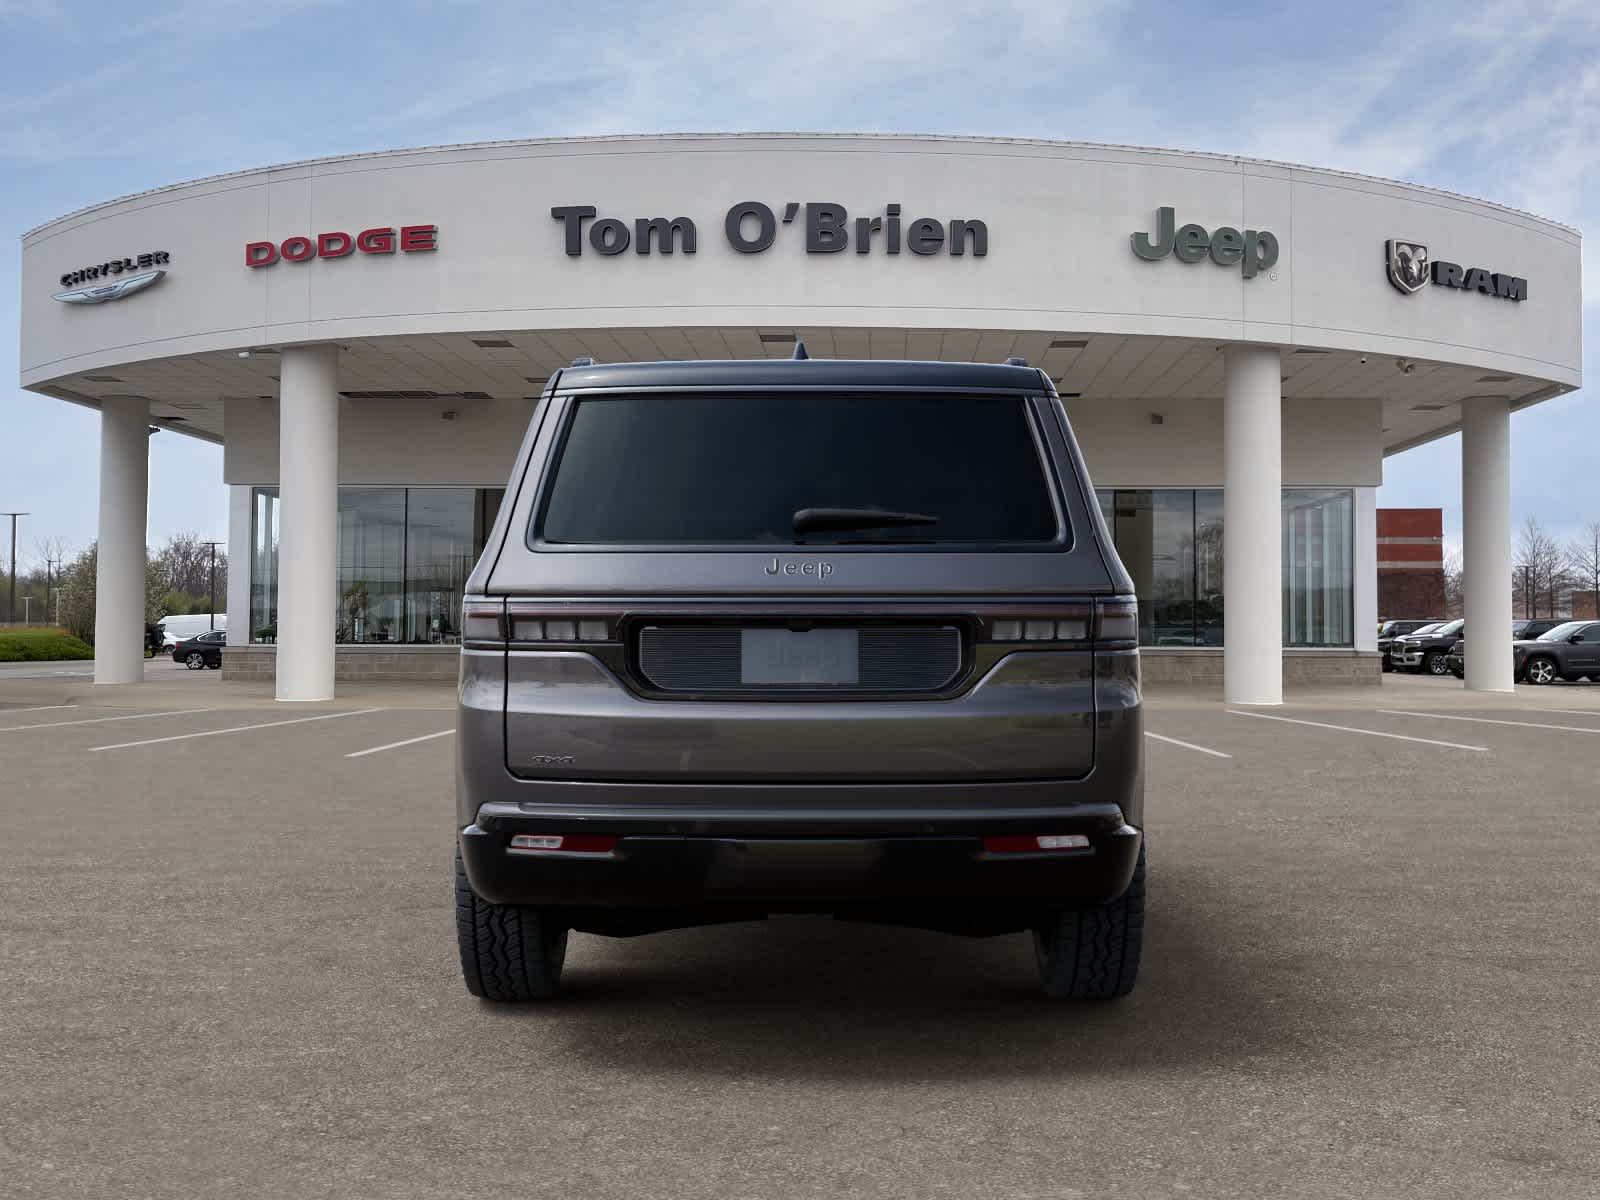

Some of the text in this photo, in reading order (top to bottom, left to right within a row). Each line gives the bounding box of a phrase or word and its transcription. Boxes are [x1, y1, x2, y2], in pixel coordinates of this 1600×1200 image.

[245, 224, 438, 269] DODGE
[551, 201, 988, 256] Tom O'Brien
[1130, 207, 1279, 279] Jeep
[60, 250, 170, 287] CHRYSLER
[1431, 261, 1528, 302] RAM
[764, 557, 834, 580] Jeep
